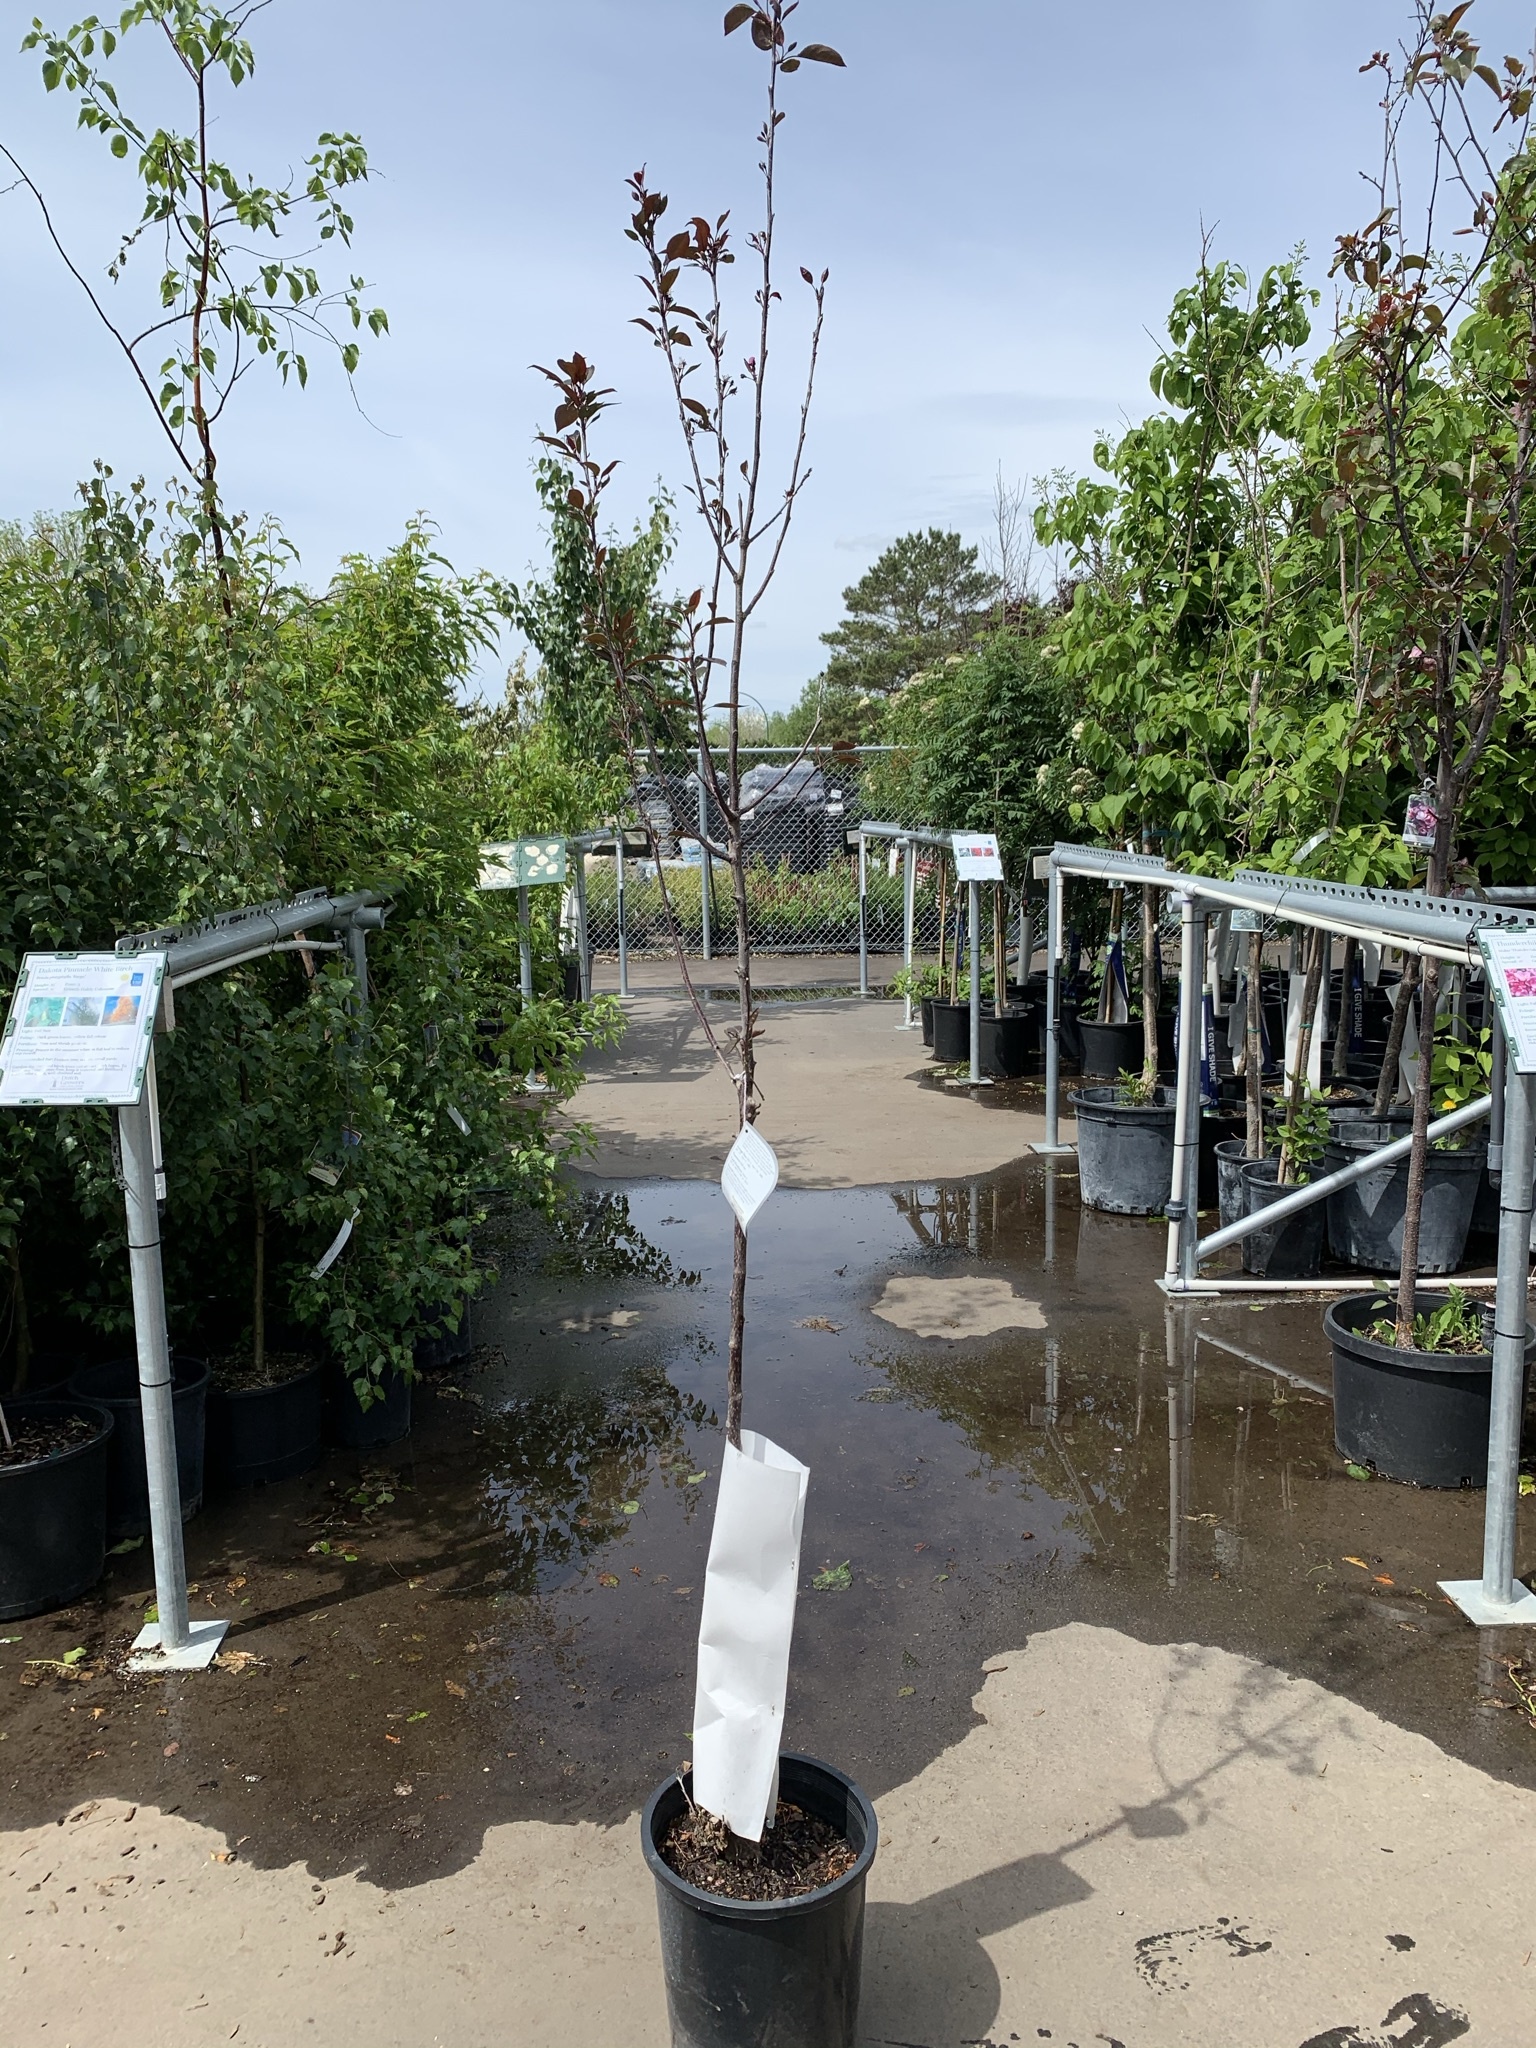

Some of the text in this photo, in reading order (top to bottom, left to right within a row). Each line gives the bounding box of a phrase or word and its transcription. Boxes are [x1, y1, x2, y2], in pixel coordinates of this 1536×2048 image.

[95, 965, 113, 973] White
[1354, 993, 1362, 1011] GIVE
[1354, 1012, 1363, 1038] SHADE
[1207, 1032, 1216, 1053] GIVE
[1208, 1053, 1217, 1083] SHADE
